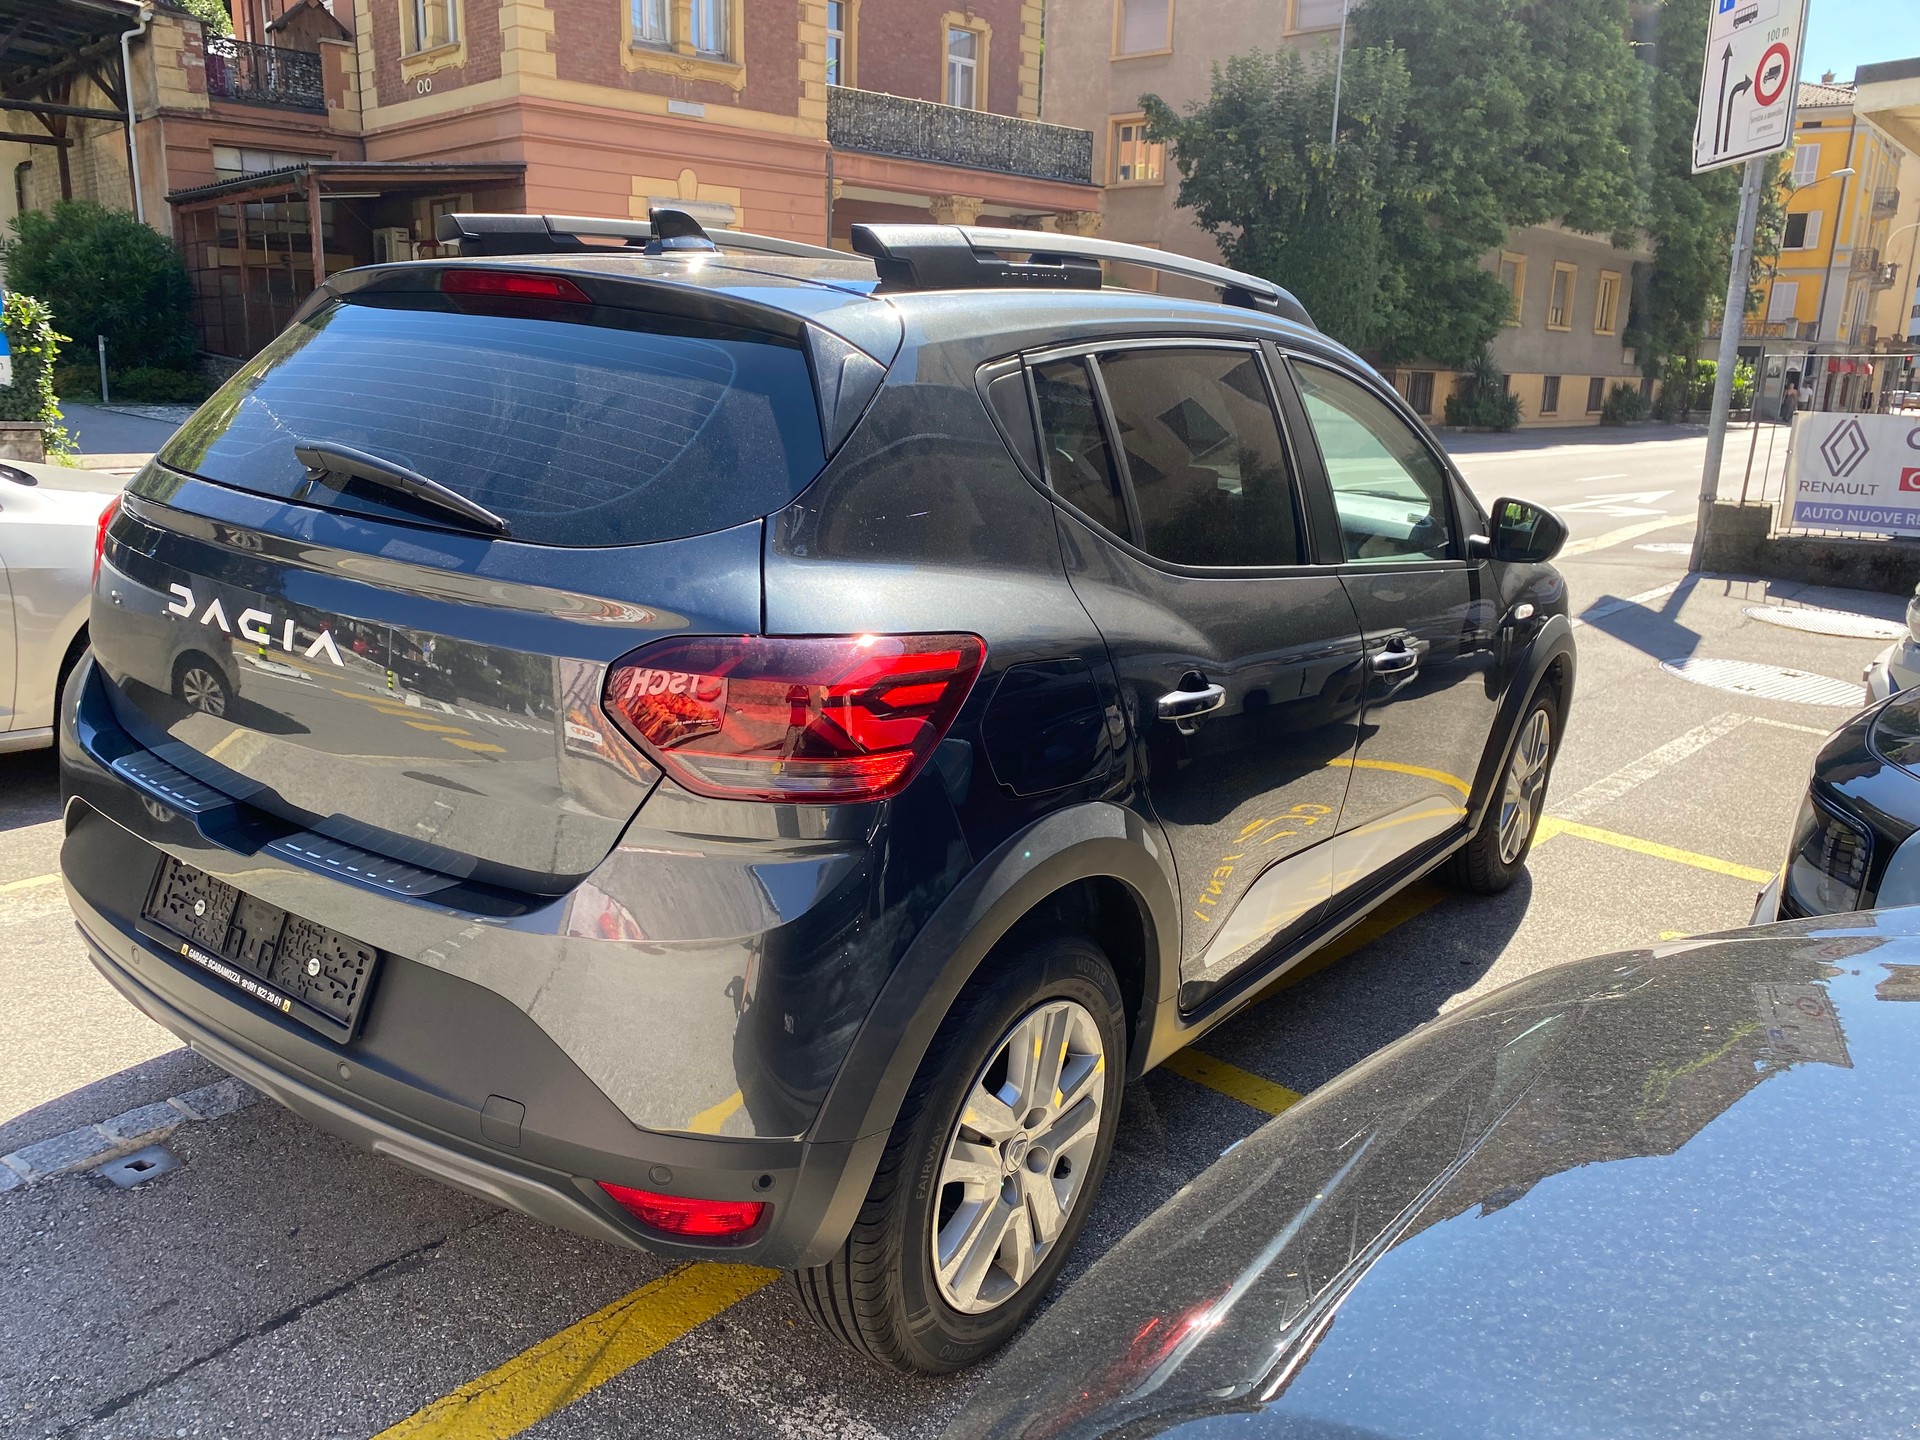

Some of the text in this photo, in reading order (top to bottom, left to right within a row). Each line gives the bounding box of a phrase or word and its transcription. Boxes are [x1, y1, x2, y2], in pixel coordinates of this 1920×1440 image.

[1767, 26, 1789, 43] 100 m
[1799, 481, 1879, 496] RENAULT
[1801, 507, 1844, 521] AUTO
[1847, 510, 1903, 524] NUOVE
[168, 582, 345, 667] DACIA
[188, 948, 208, 966] GARAGE
[207, 959, 241, 984] SCARAMOZZA
[248, 981, 257, 993] 091
[257, 986, 267, 999] 922
[266, 991, 275, 1003] 20
[1075, 957, 1108, 986] MOTRIO
[915, 1122, 945, 1200] FAIRWAY
